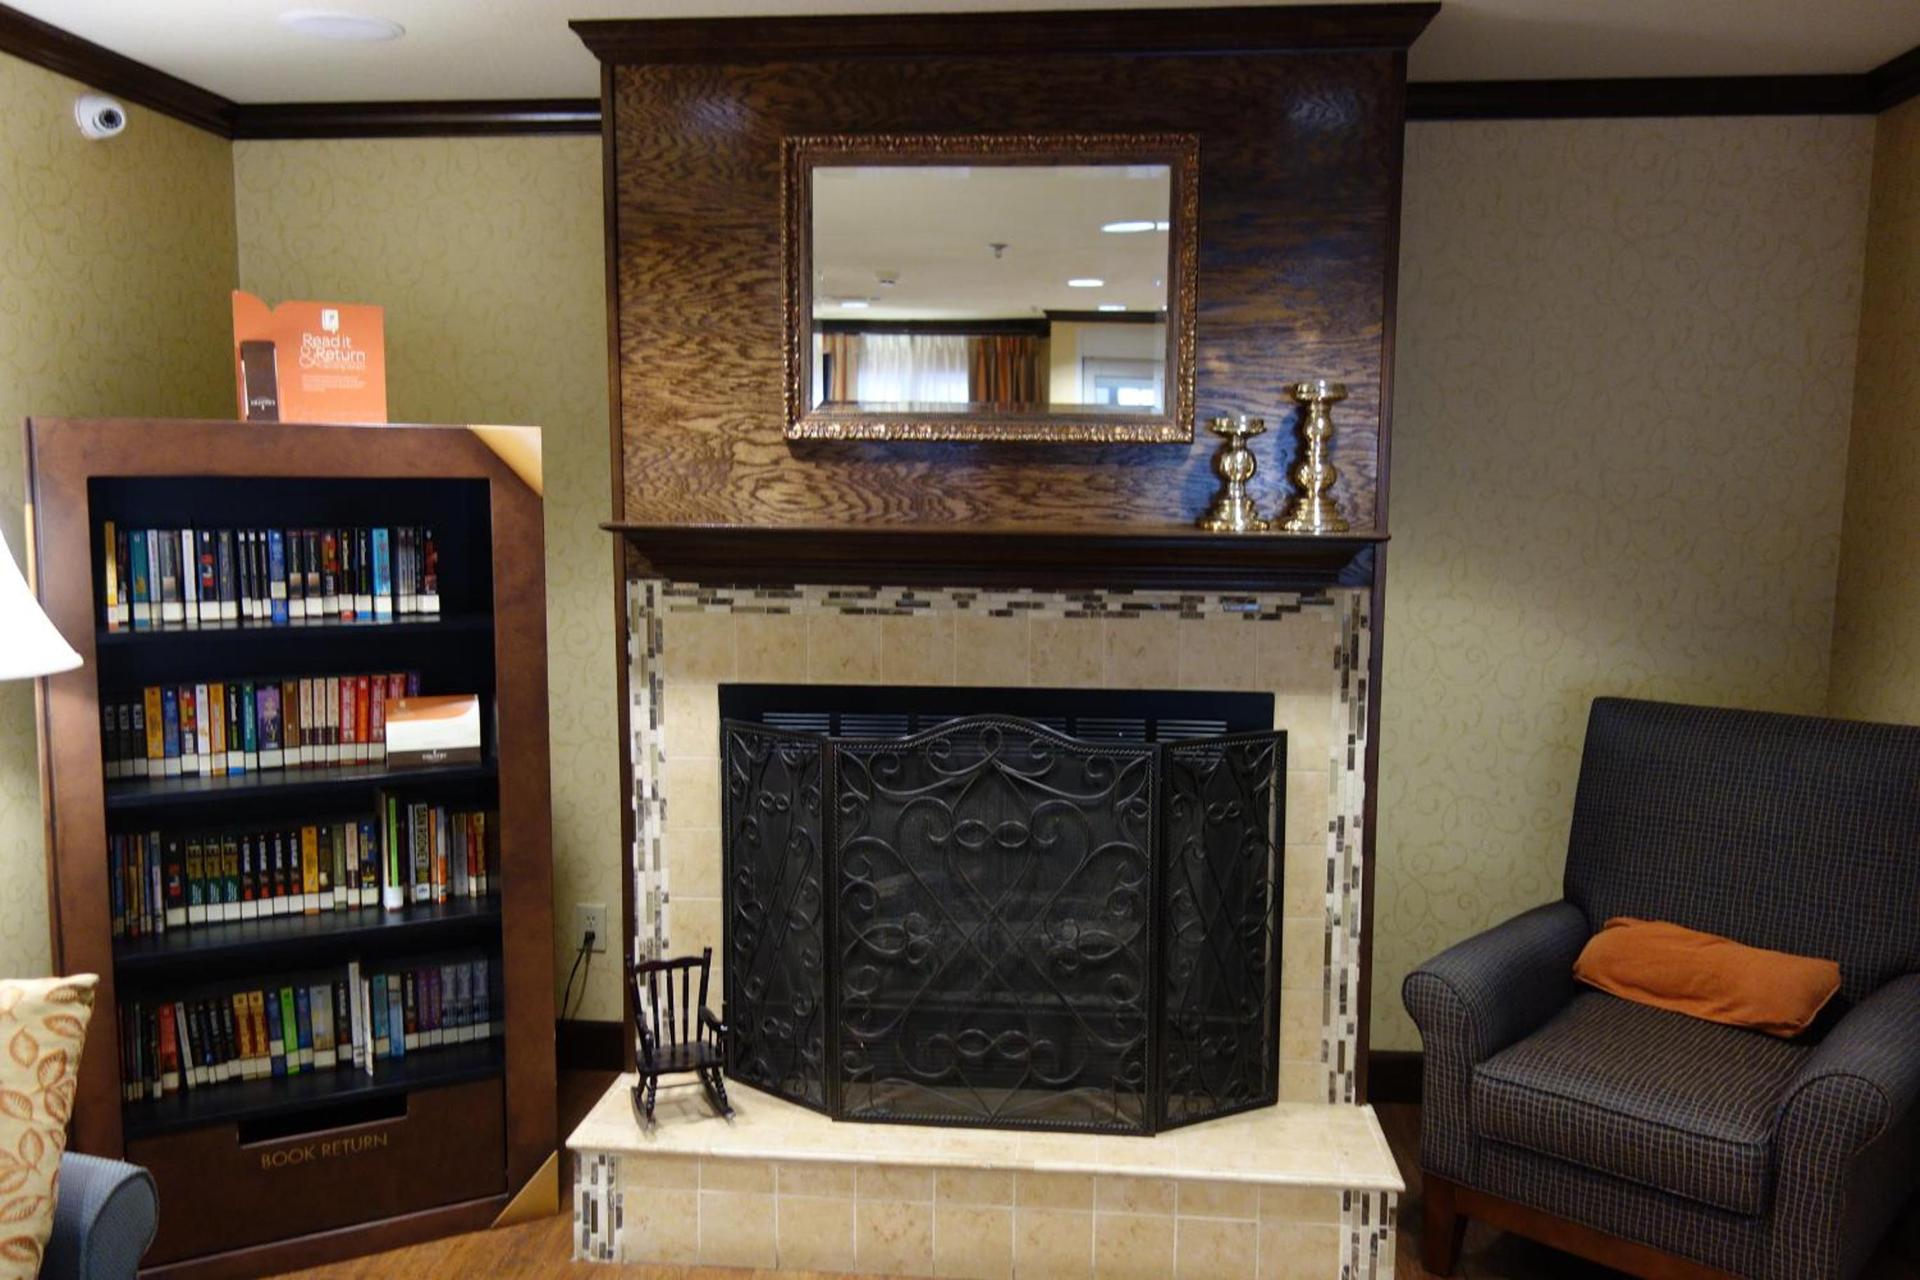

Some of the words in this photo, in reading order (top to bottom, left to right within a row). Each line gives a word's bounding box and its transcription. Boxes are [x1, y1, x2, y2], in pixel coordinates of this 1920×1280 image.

[302, 332, 340, 348] Read
[343, 334, 352, 348] it
[299, 345, 315, 368] &
[315, 347, 365, 362] Return
[261, 1144, 316, 1169] BOOK
[321, 1132, 388, 1157] RETURN
